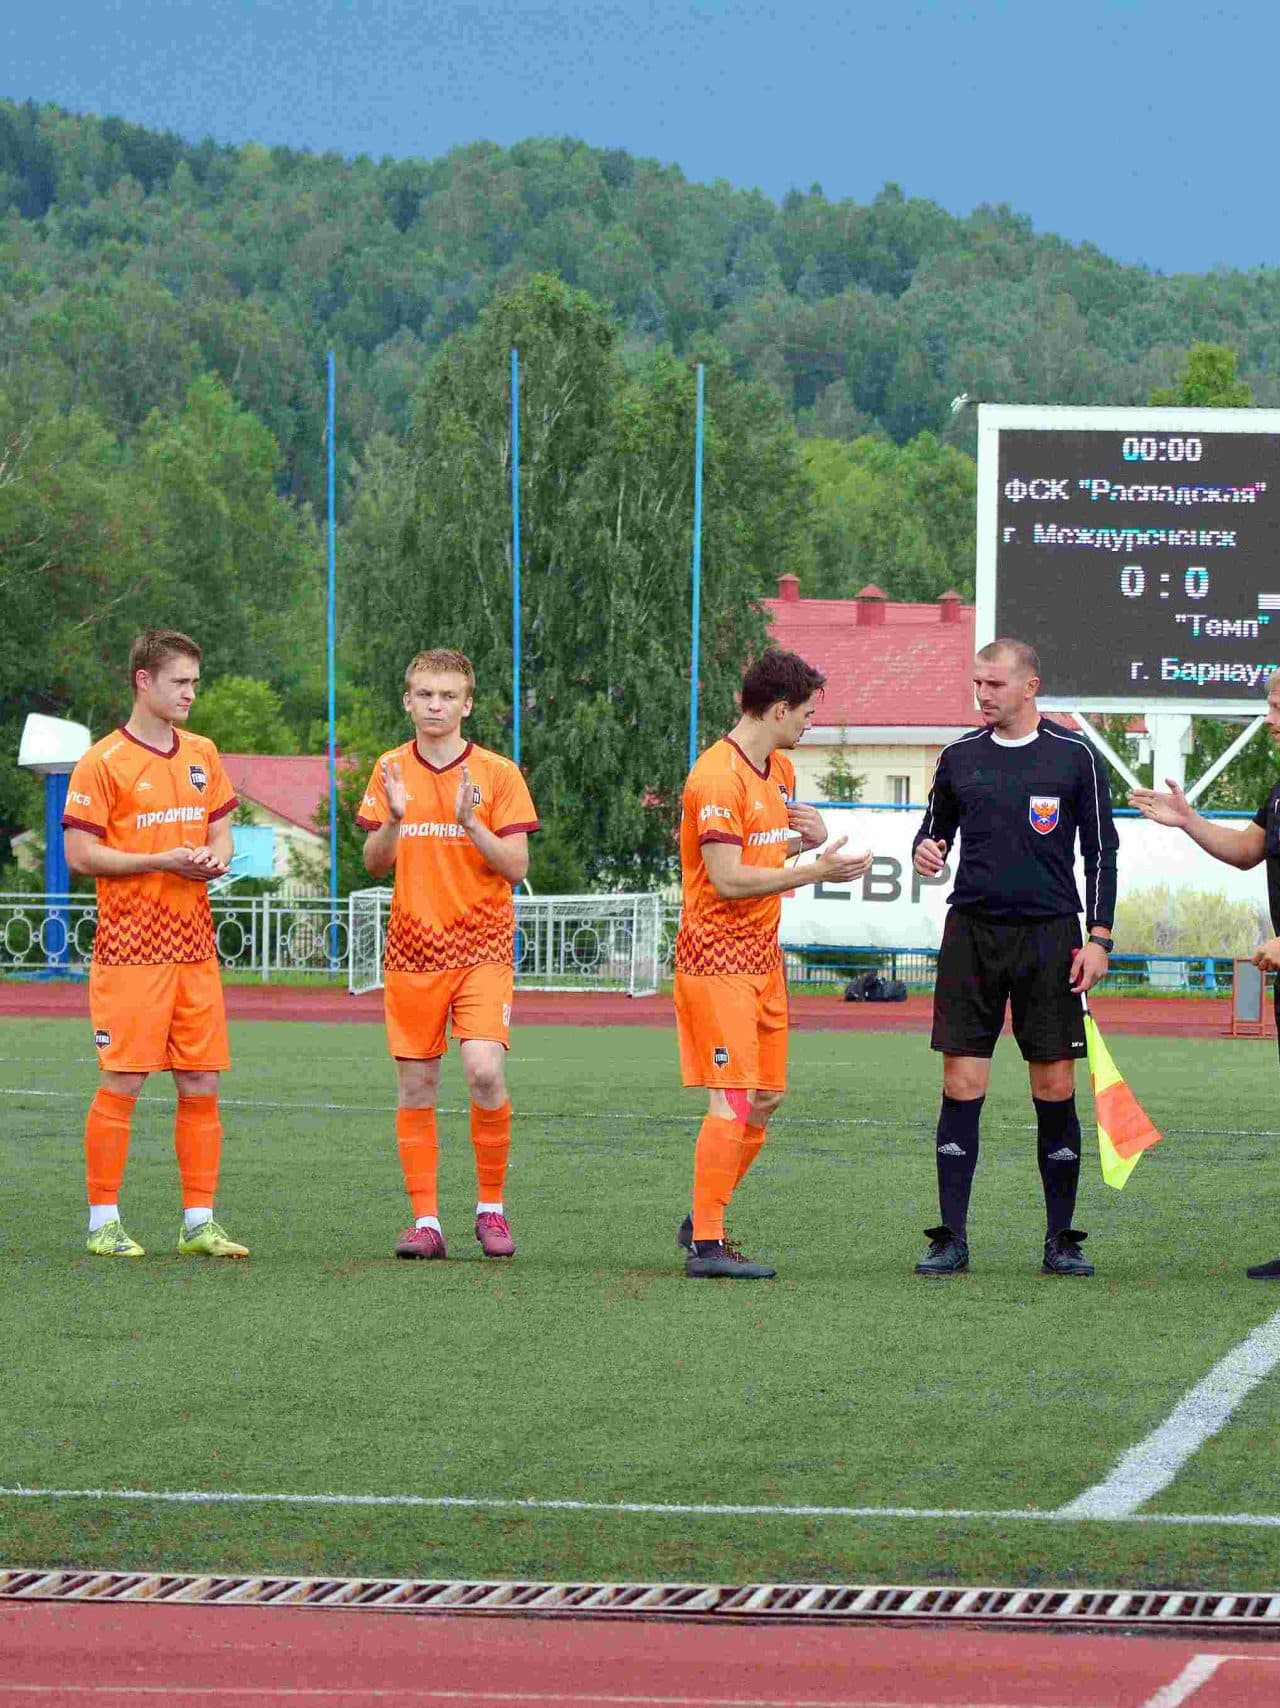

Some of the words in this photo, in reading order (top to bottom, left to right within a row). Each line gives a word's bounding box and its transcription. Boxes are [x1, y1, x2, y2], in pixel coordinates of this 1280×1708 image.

[1122, 437, 1202, 462] 00:00
[1003, 478, 1070, 502] ФСК
[1174, 613, 1270, 637] "Темп"
